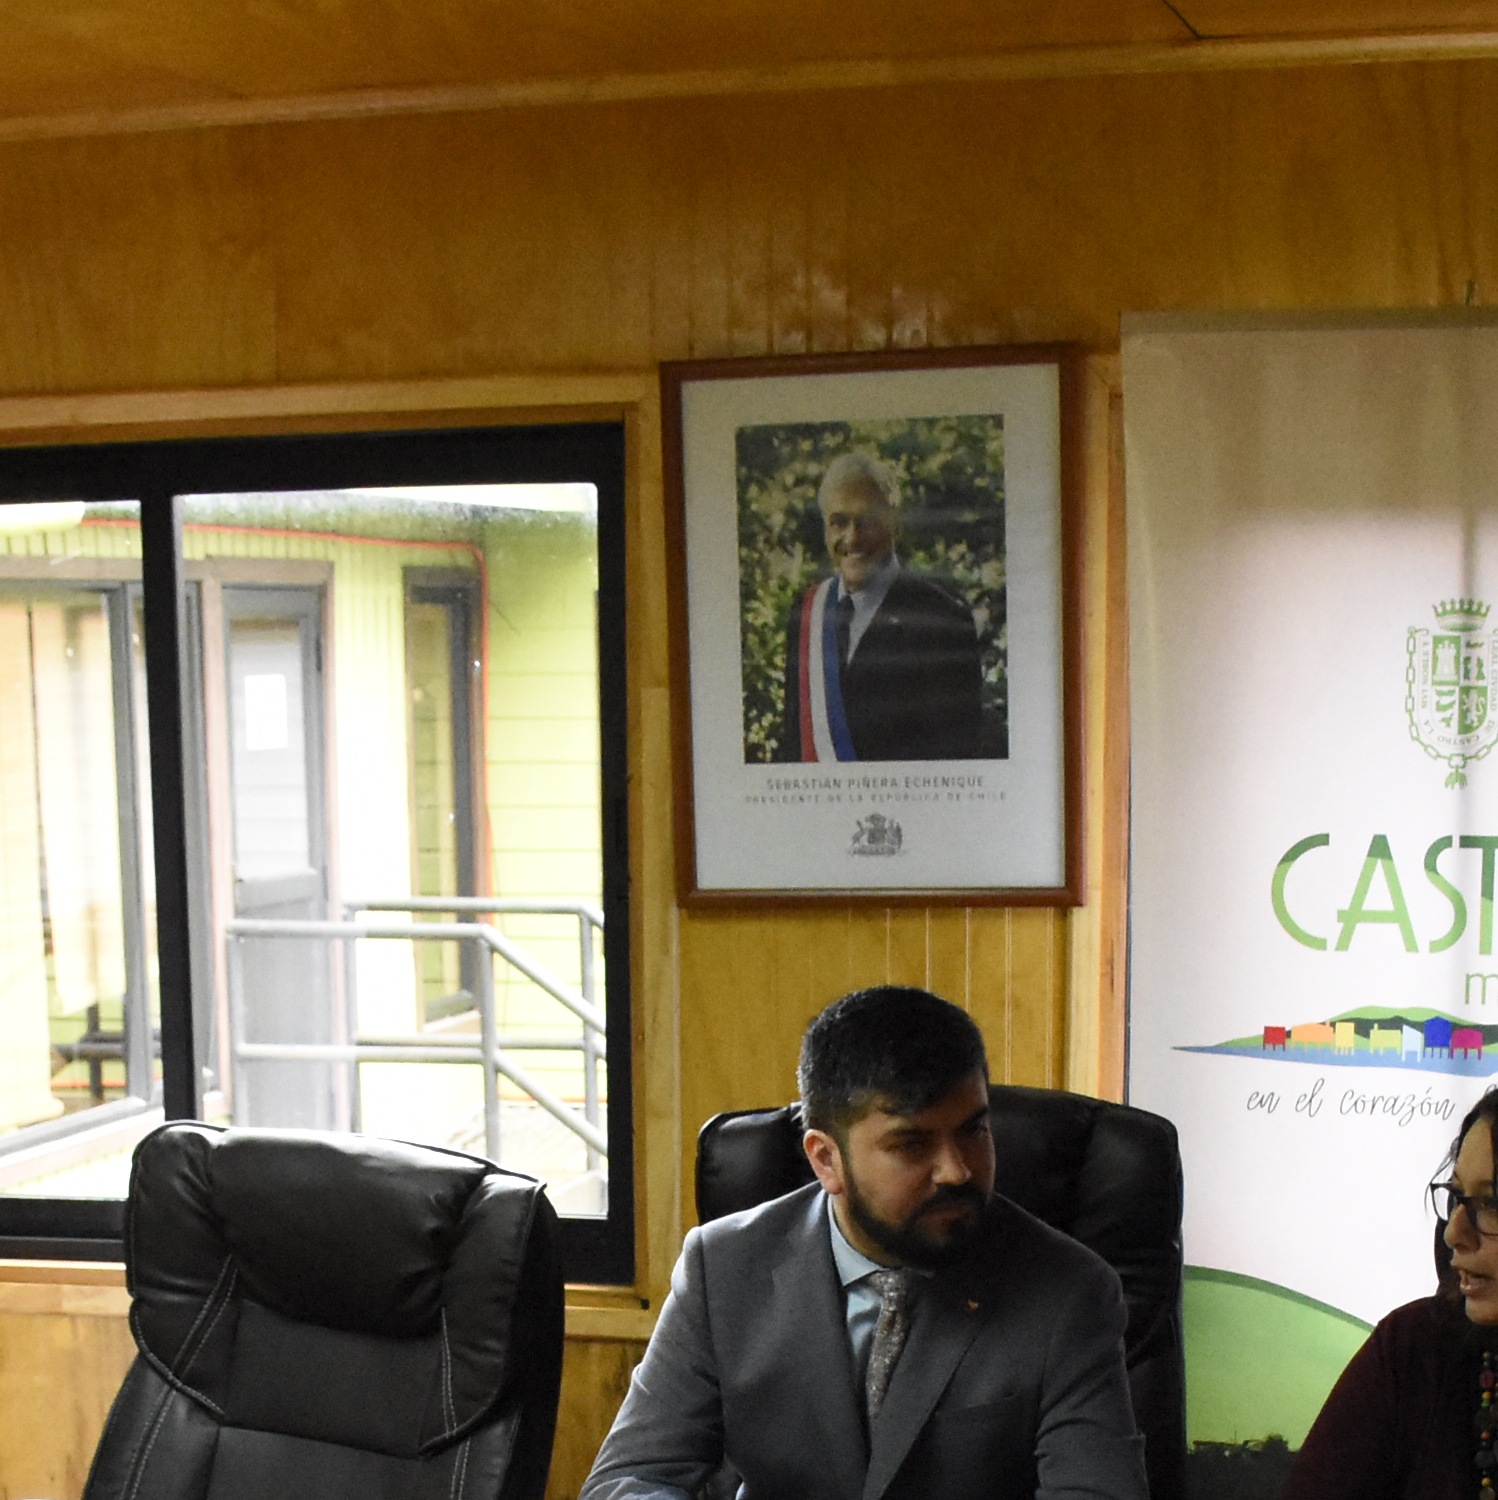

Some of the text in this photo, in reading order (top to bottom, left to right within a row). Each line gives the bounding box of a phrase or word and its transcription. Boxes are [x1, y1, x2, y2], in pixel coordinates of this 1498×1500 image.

[847, 774, 899, 790] PIÑERA
[903, 774, 984, 790] ECHENIQUE
[1246, 1077, 1456, 1127] en el corazón
